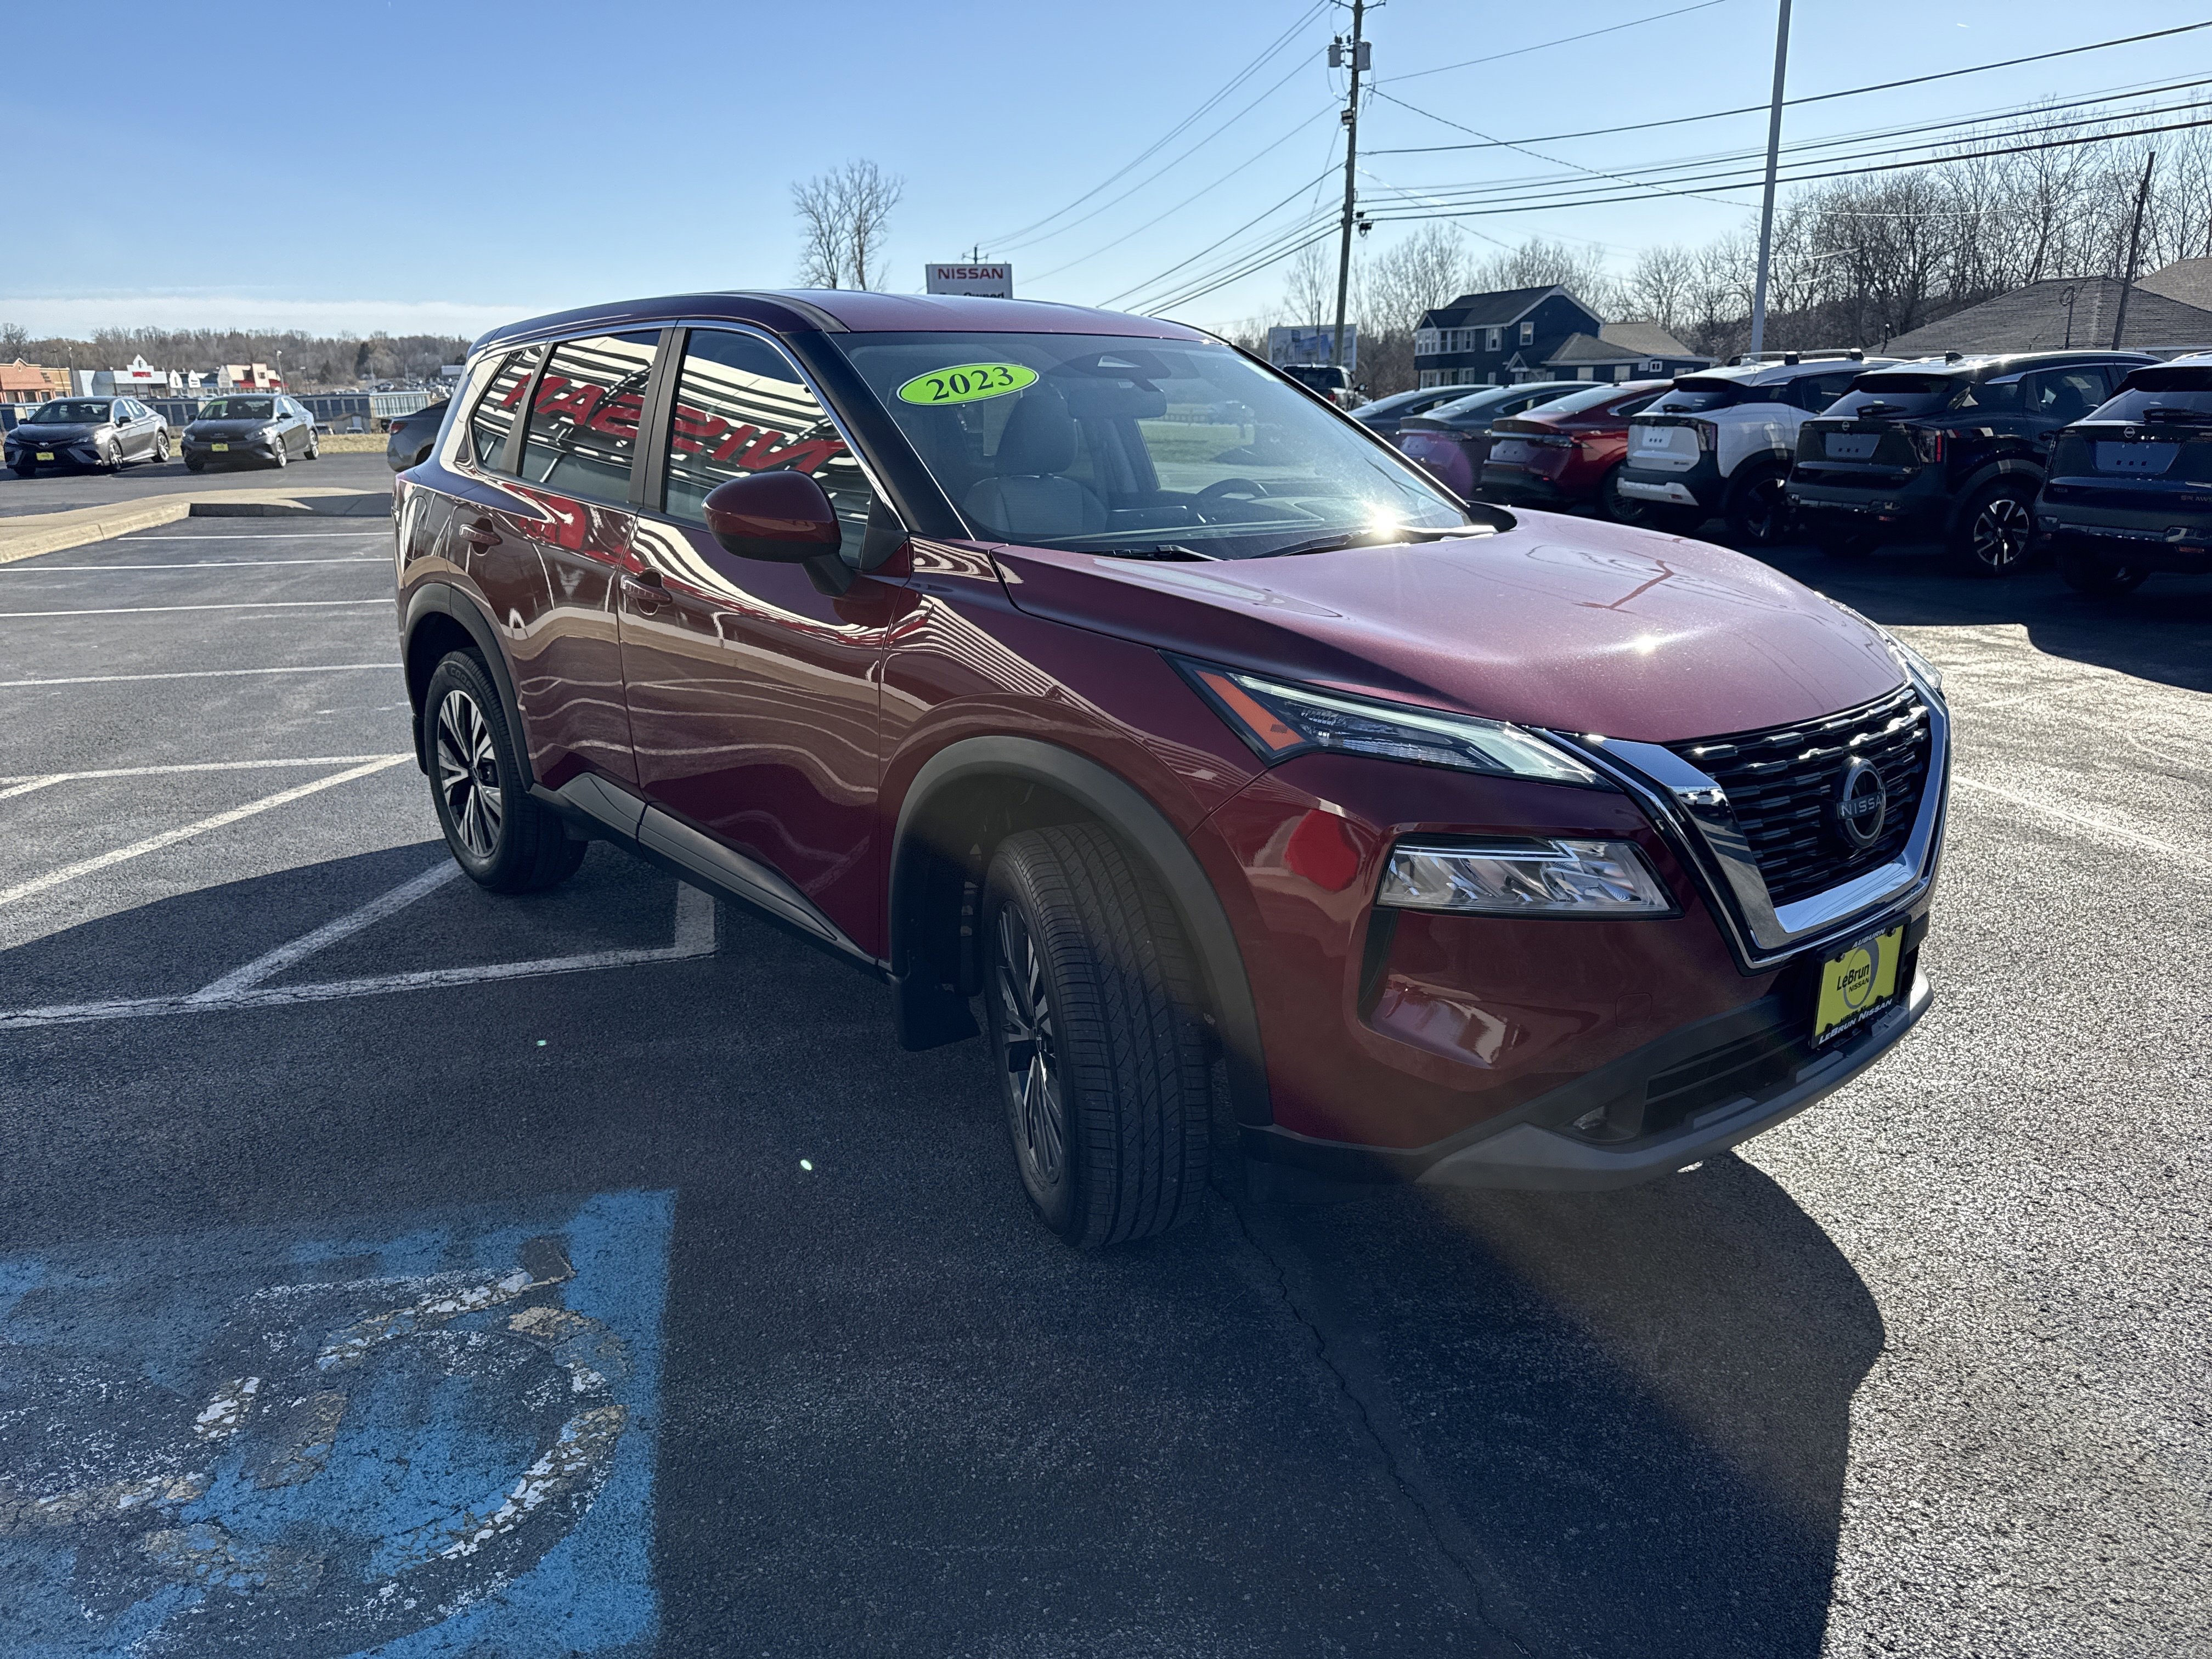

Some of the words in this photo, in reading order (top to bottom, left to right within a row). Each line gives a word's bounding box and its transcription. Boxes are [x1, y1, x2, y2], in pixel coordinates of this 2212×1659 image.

[938, 268, 1003, 279] NISSAN
[926, 366, 1014, 401] 2023
[1852, 928, 1886, 949] AUBURN
[1837, 964, 1870, 991] LeBrun
[1849, 977, 1870, 992] NISSAN
[1858, 998, 1892, 1022] NISSAN
